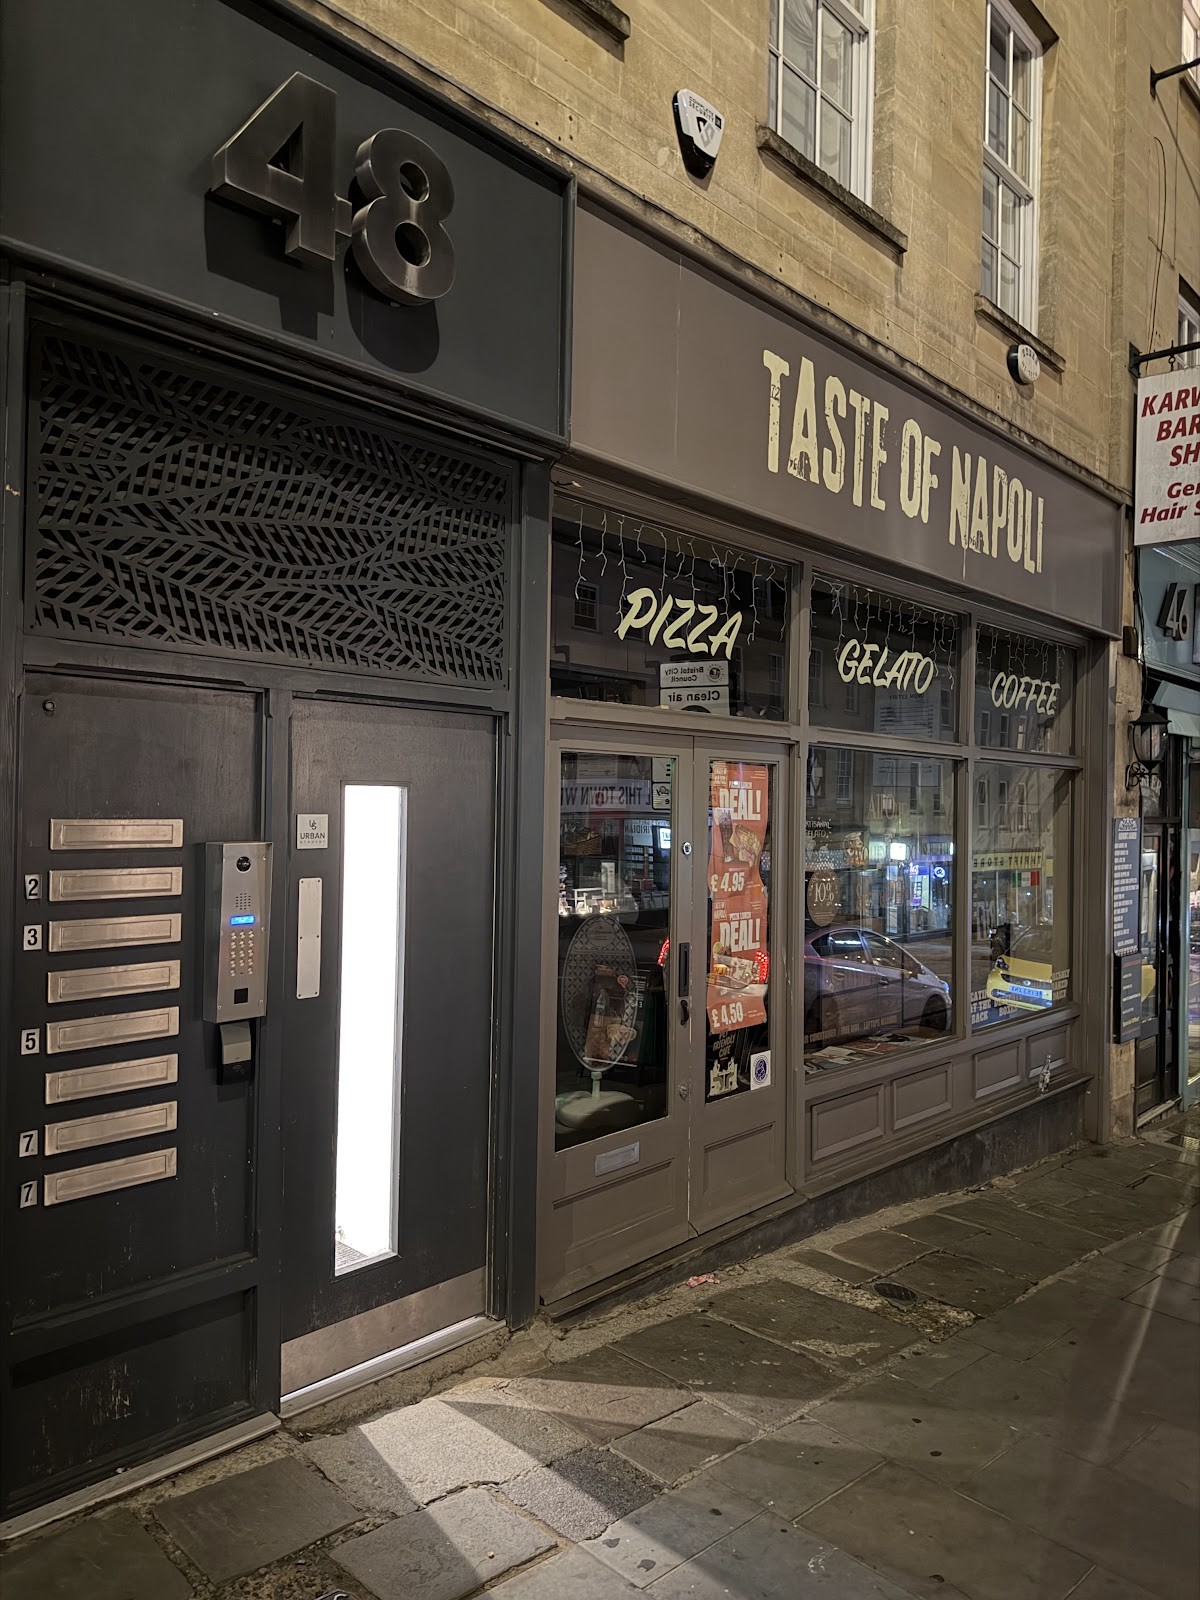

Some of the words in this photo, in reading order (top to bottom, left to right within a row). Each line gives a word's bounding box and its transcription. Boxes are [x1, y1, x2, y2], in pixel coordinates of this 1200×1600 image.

[689, 101, 714, 122] SECURITY
[210, 71, 455, 306] 48
[763, 350, 889, 511] TASTE
[900, 419, 941, 523] OF
[949, 445, 1044, 574] NAPOLI
[1140, 502, 1188, 524] Hair
[618, 587, 743, 660] PIZZA
[1156, 583, 1190, 641] 46
[838, 639, 934, 694] GELATO
[992, 672, 1061, 716] COFFEE
[719, 788, 761, 820] DEAL!
[300, 832, 326, 840] URBAN
[27, 878, 39, 897] 2
[711, 874, 718, 892] £
[720, 872, 745, 892] 4.95
[27, 929, 38, 946] 3
[719, 918, 761, 952] DEAL!
[711, 1008, 720, 1028] £
[721, 1001, 744, 1025] 4.50
[25, 1033, 36, 1051] 5
